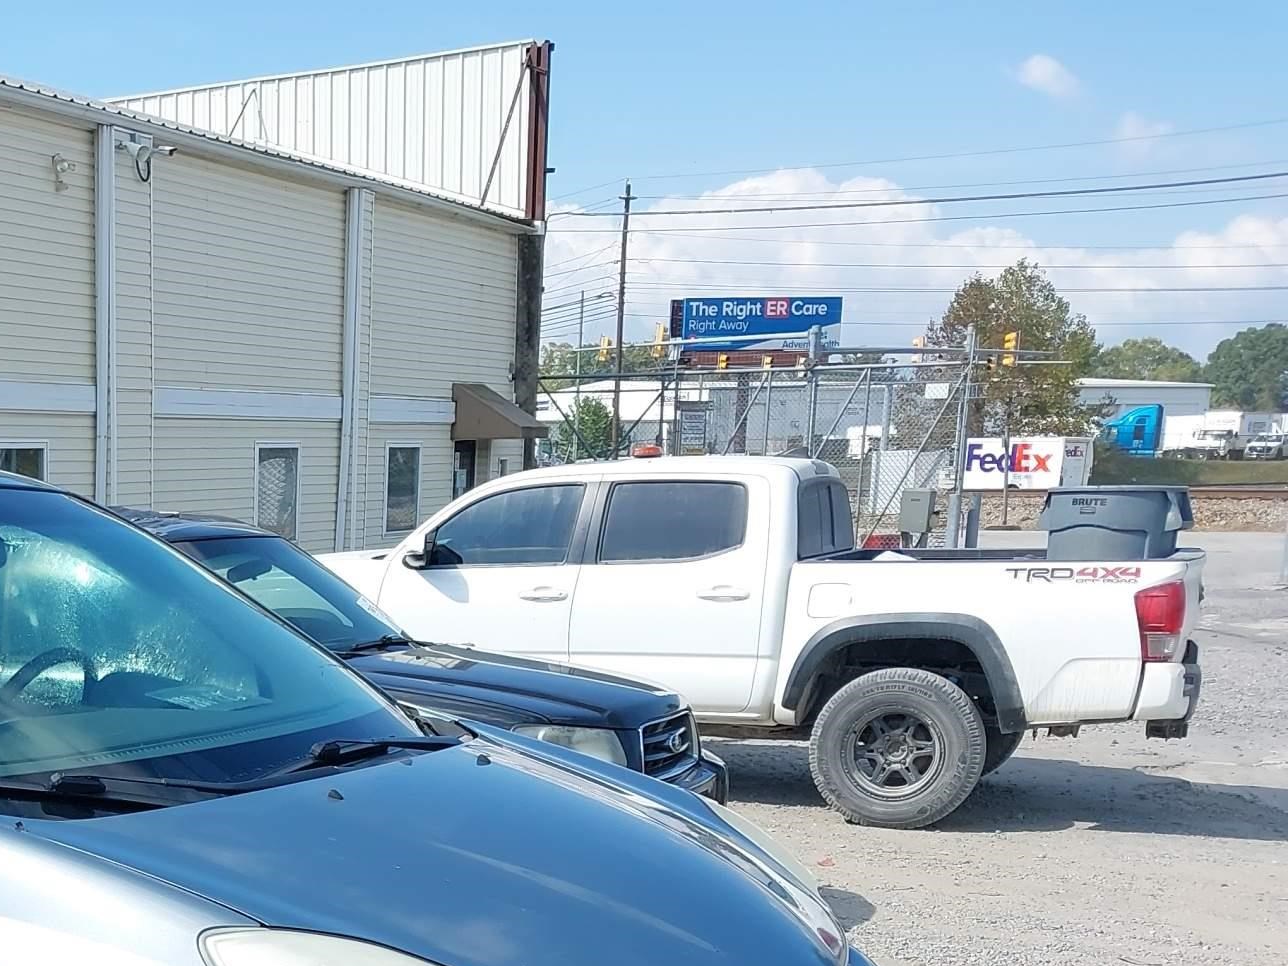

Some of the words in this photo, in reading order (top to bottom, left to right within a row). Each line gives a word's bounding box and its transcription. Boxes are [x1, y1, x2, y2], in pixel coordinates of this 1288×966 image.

[689, 301, 718, 317] The
[722, 301, 762, 320] Right
[766, 300, 788, 316] ER
[791, 300, 828, 316] Care
[688, 319, 716, 333] Right
[718, 319, 749, 332] Away
[966, 443, 1053, 473] FedEx
[1071, 497, 1108, 507] BRUTE
[1005, 567, 1074, 583] TRD
